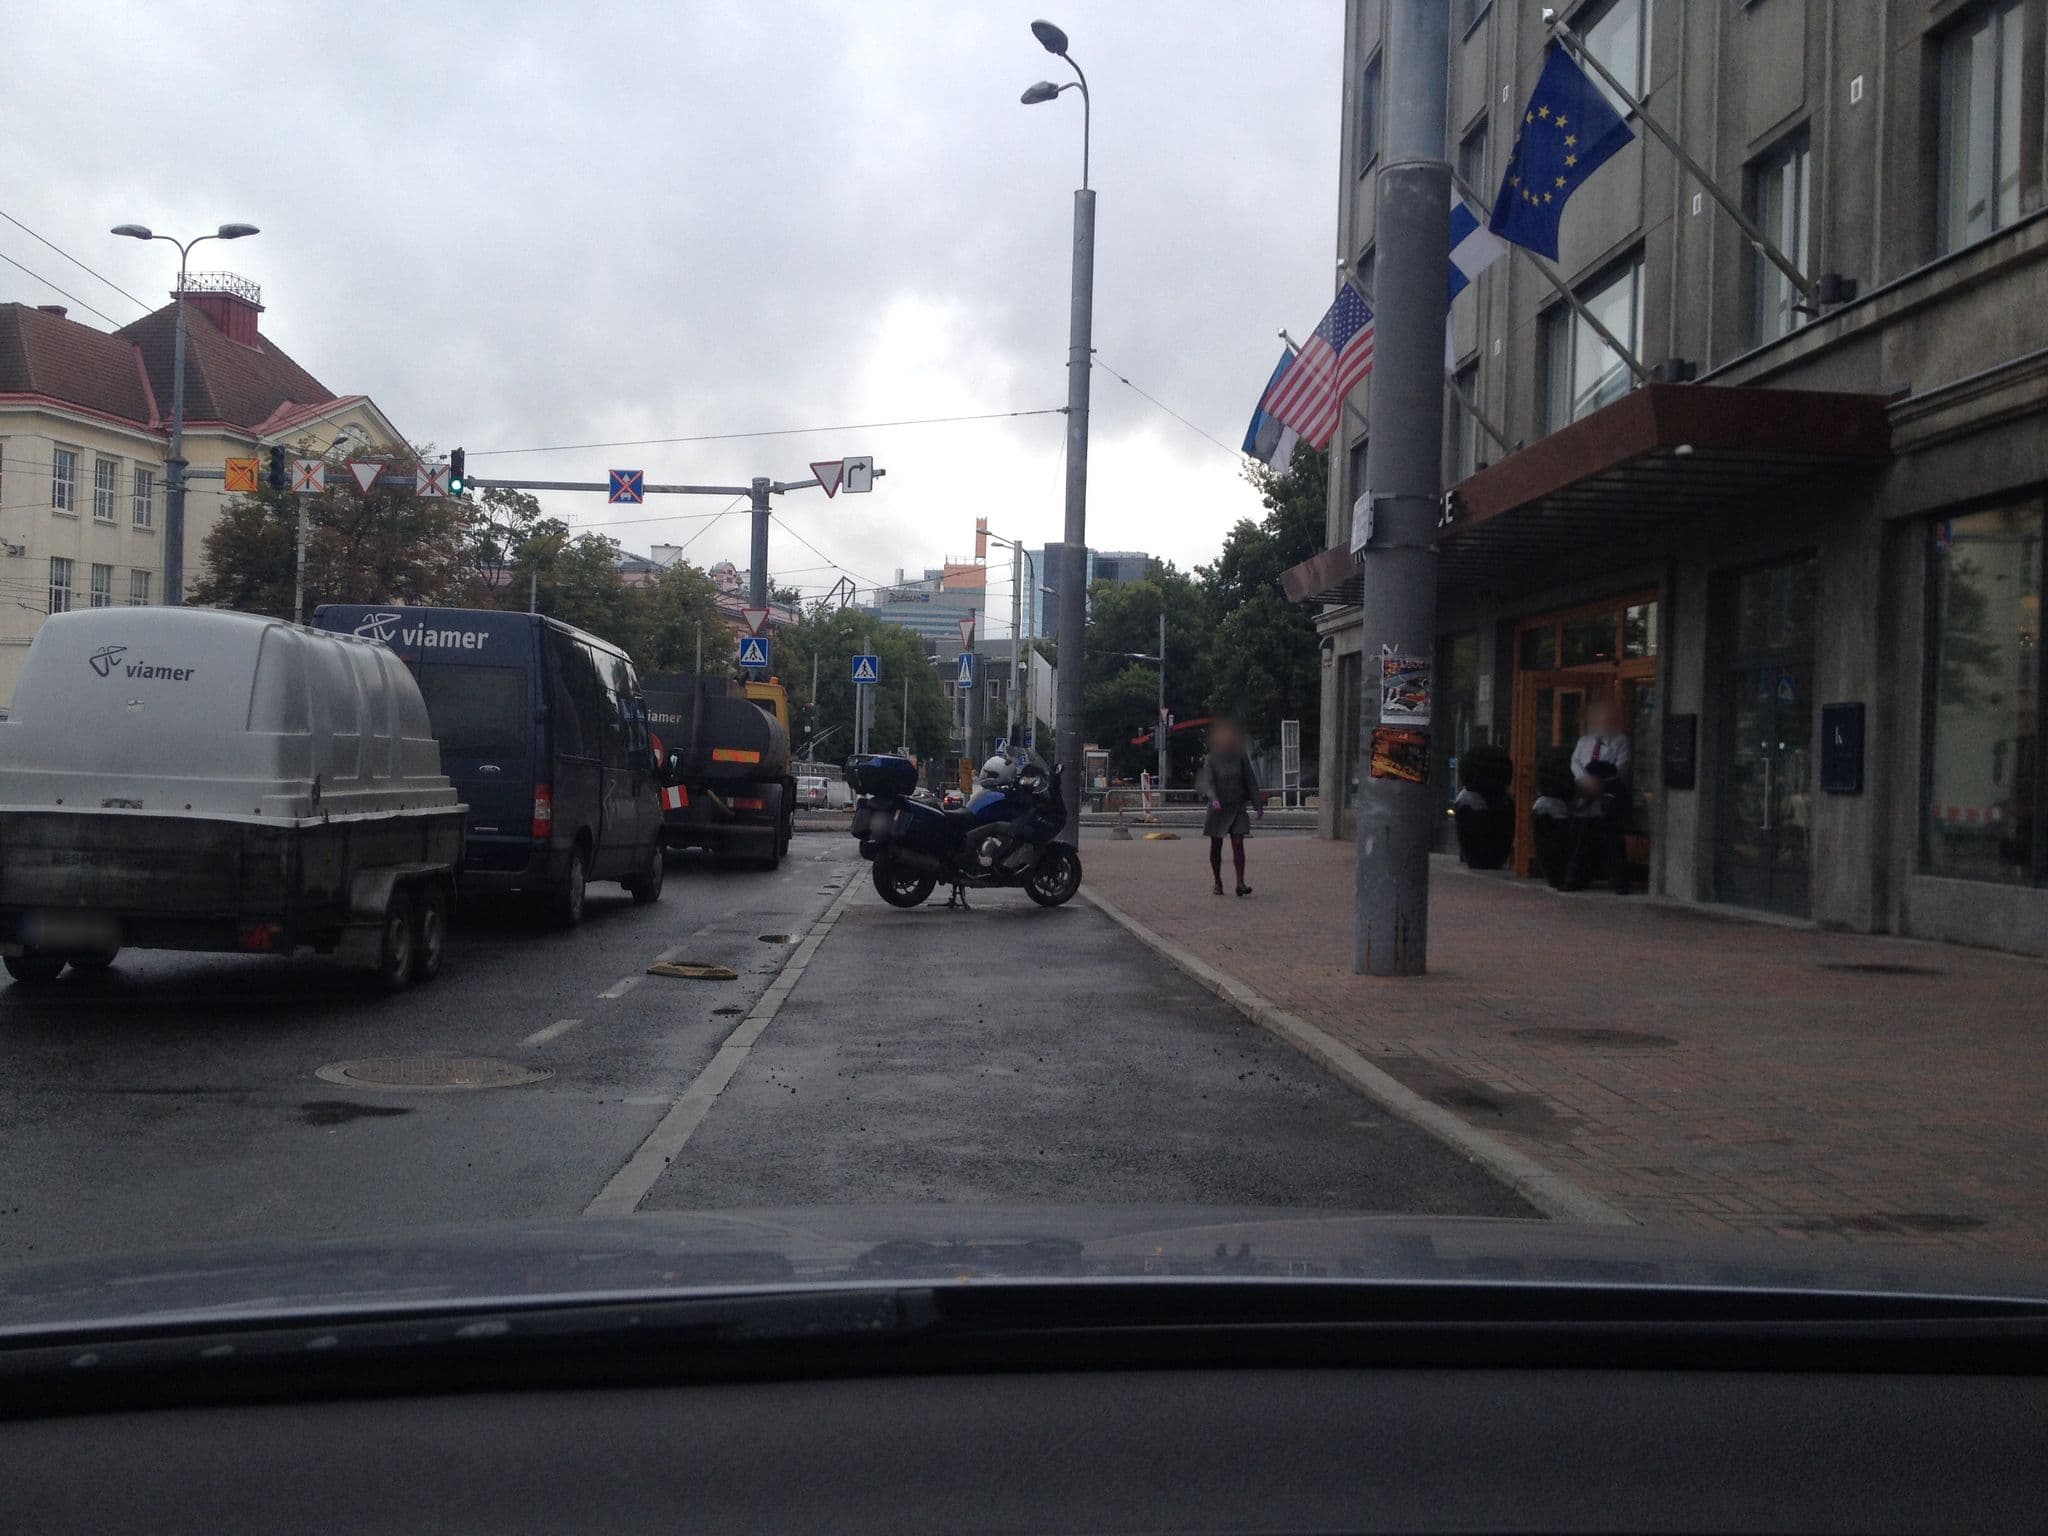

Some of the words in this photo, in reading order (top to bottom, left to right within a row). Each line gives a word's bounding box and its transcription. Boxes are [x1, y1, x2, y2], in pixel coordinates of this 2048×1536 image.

[402, 622, 489, 650] viamer
[126, 661, 195, 681] viamer
[647, 709, 682, 724] iamer
